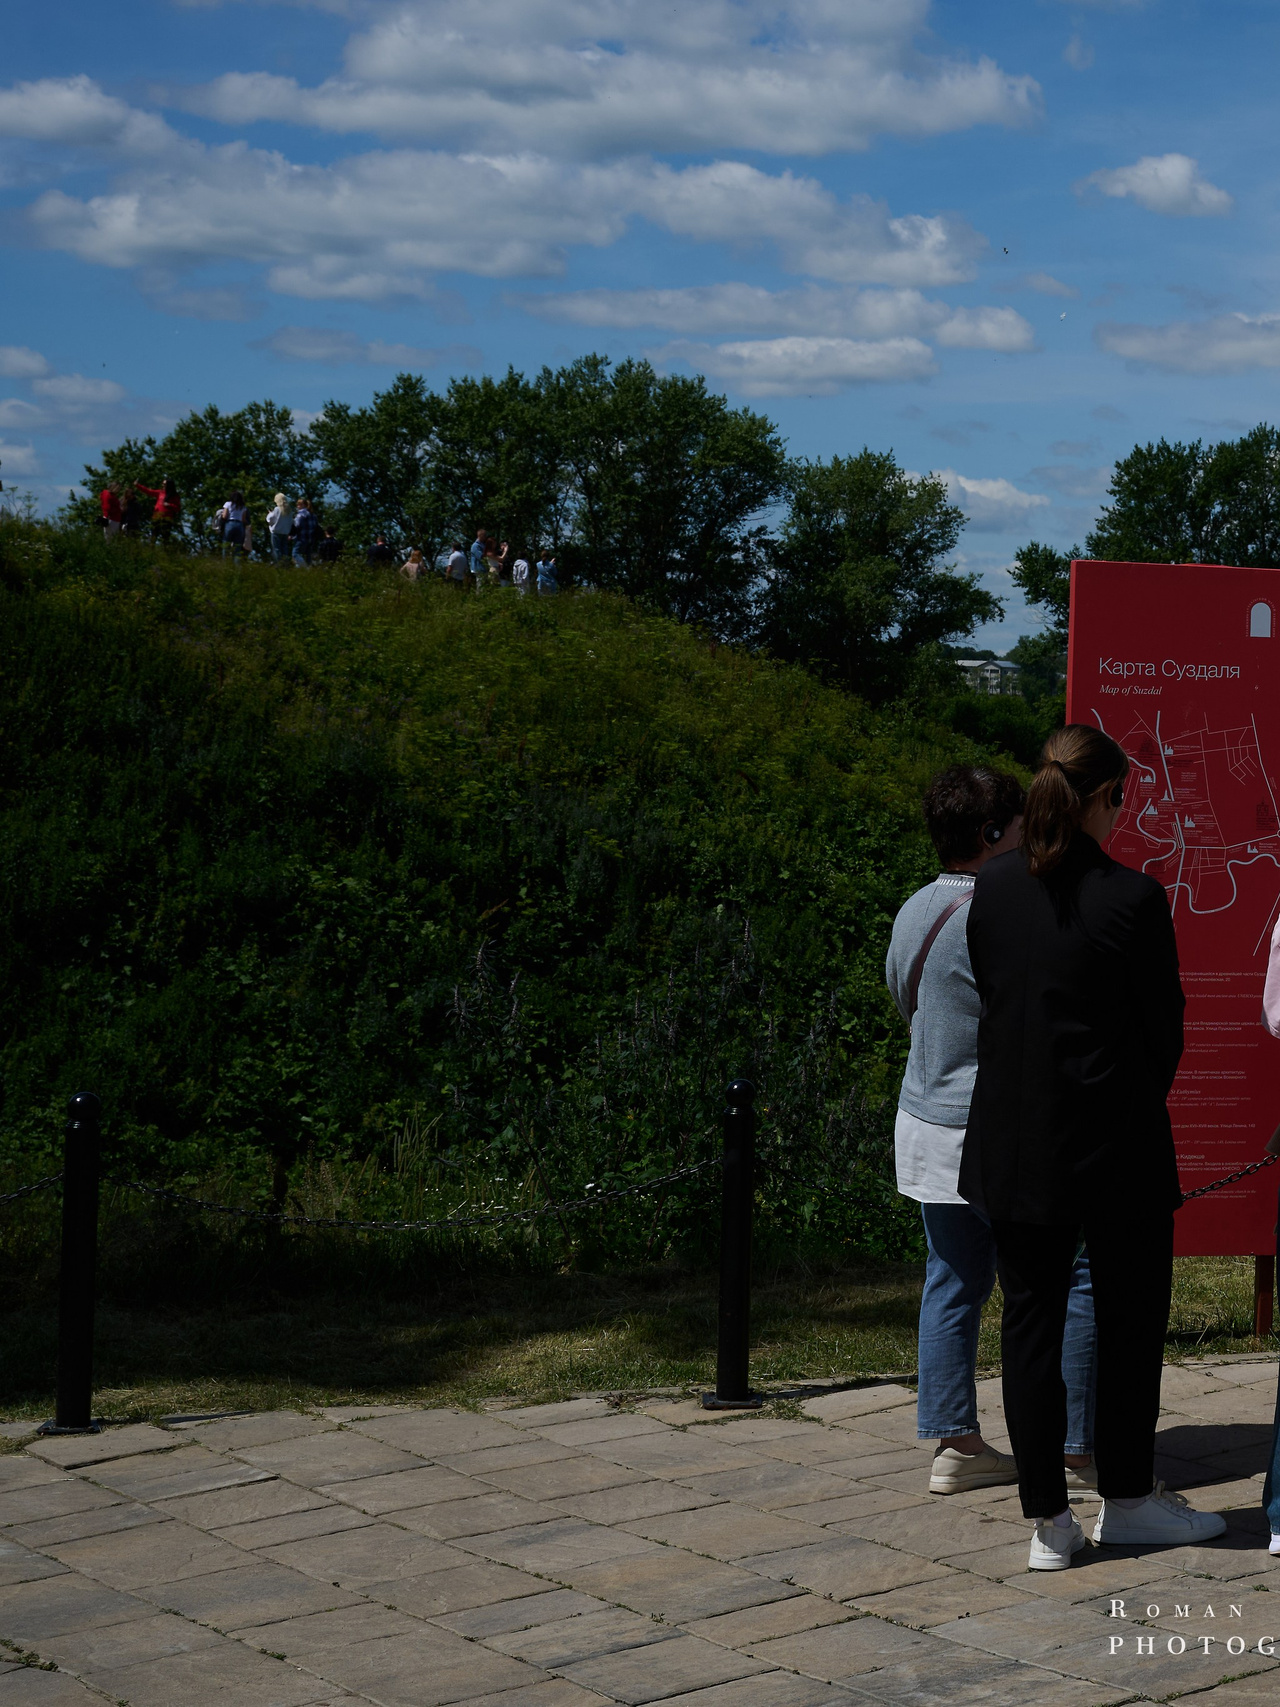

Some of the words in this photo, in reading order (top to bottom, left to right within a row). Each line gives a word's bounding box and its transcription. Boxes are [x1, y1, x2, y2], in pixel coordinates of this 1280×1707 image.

[1099, 657, 1156, 679] Карта
[1161, 659, 1240, 681] Суздаля
[1099, 685, 1119, 696] Map
[1121, 686, 1132, 696] of
[1132, 686, 1163, 695] Suzdal
